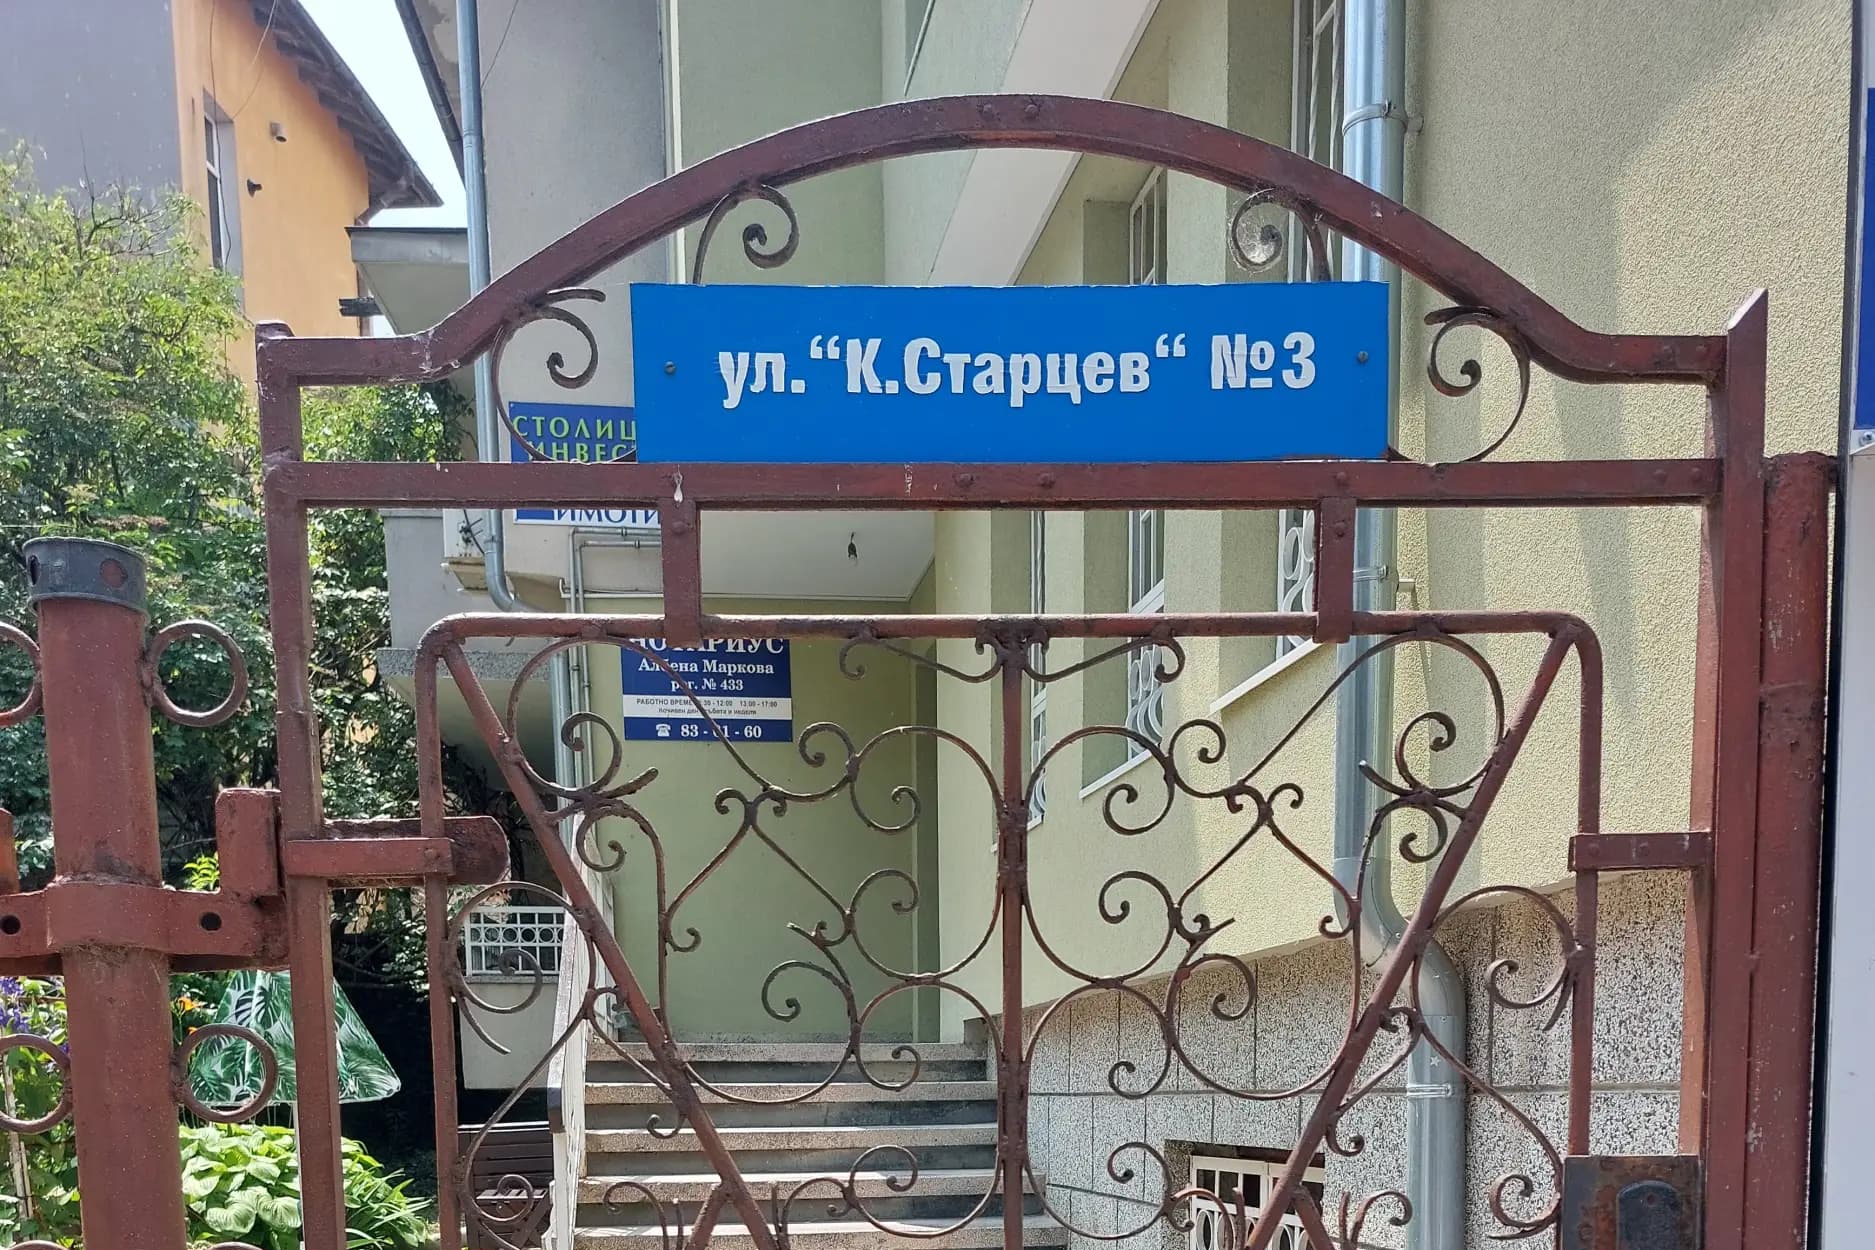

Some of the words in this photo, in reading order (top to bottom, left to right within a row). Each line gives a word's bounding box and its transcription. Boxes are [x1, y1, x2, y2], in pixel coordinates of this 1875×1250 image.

[718, 348, 806, 409] ул.
[528, 441, 636, 463] ИНВЕС
[702, 658, 775, 676] Маркова
[670, 679, 698, 692] рг.
[720, 679, 744, 691] 433
[680, 724, 699, 738] 83
[743, 725, 762, 738] 60
